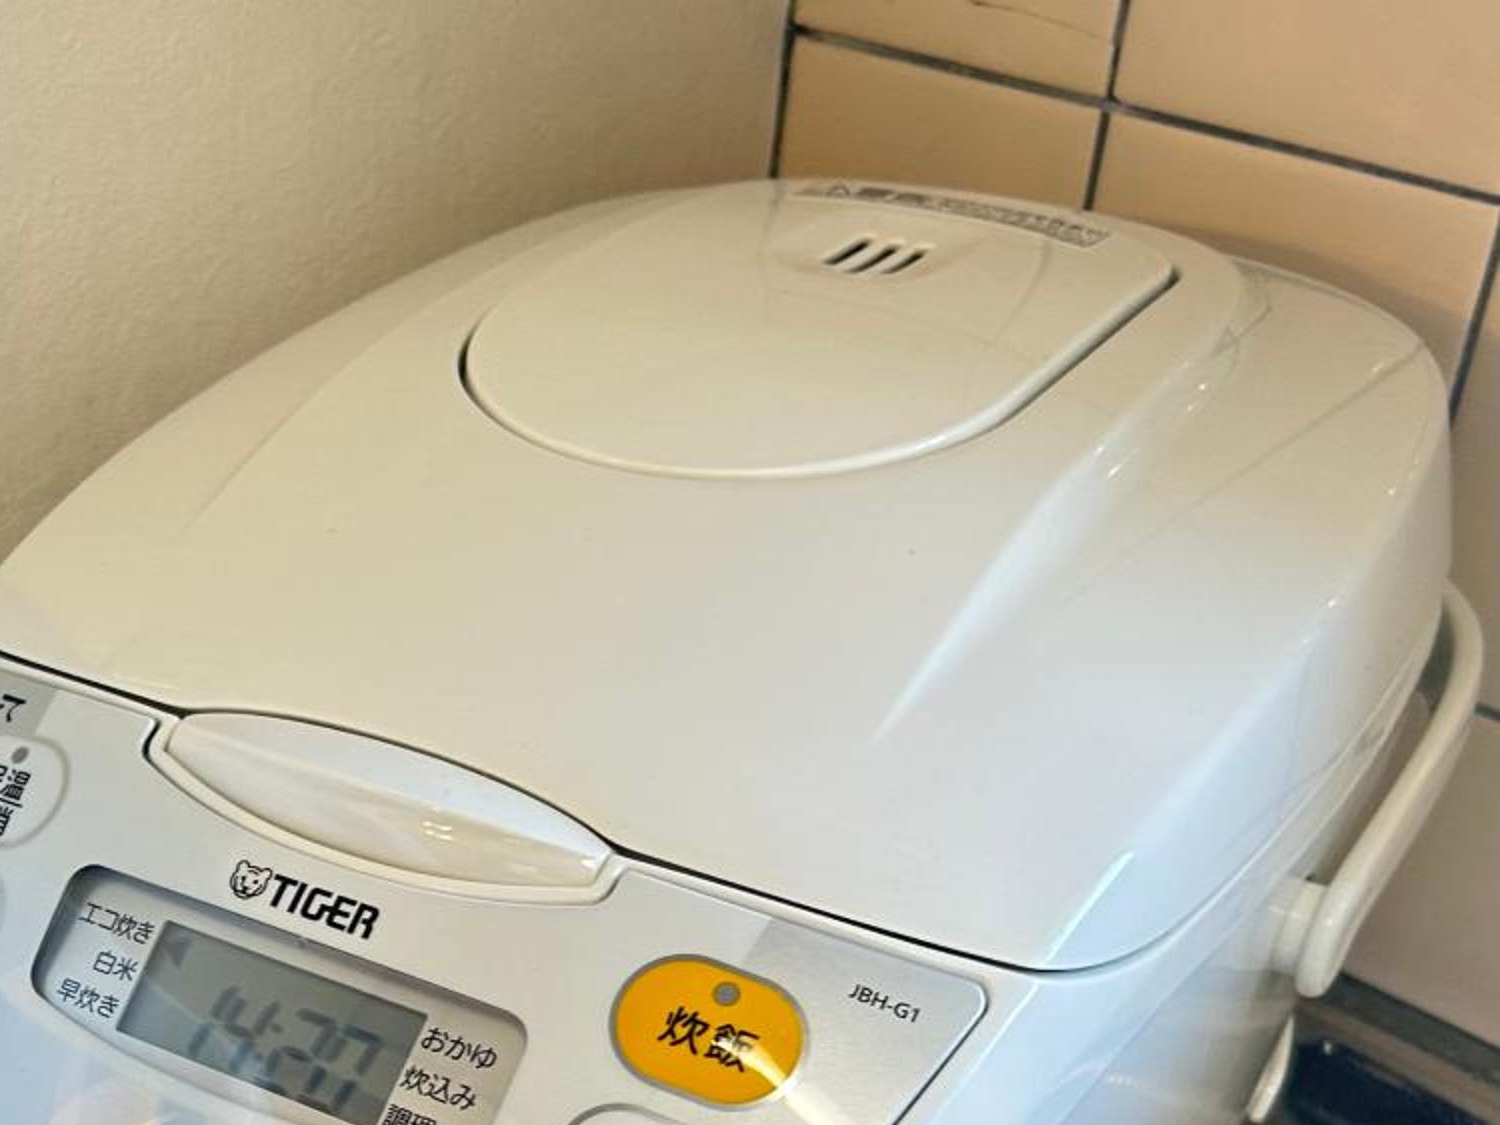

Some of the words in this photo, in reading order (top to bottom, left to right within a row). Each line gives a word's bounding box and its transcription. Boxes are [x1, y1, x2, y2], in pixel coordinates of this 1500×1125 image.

[80, 901, 155, 944] エコ炊き
[272, 875, 381, 939] TIGER
[93, 950, 138, 981] 白米
[57, 978, 118, 1019] 早炊き
[847, 983, 922, 1024] JBH-G1
[421, 1026, 499, 1070] おかゆ
[657, 1006, 760, 1073] 炊飯
[400, 1066, 477, 1112] 炊込み
